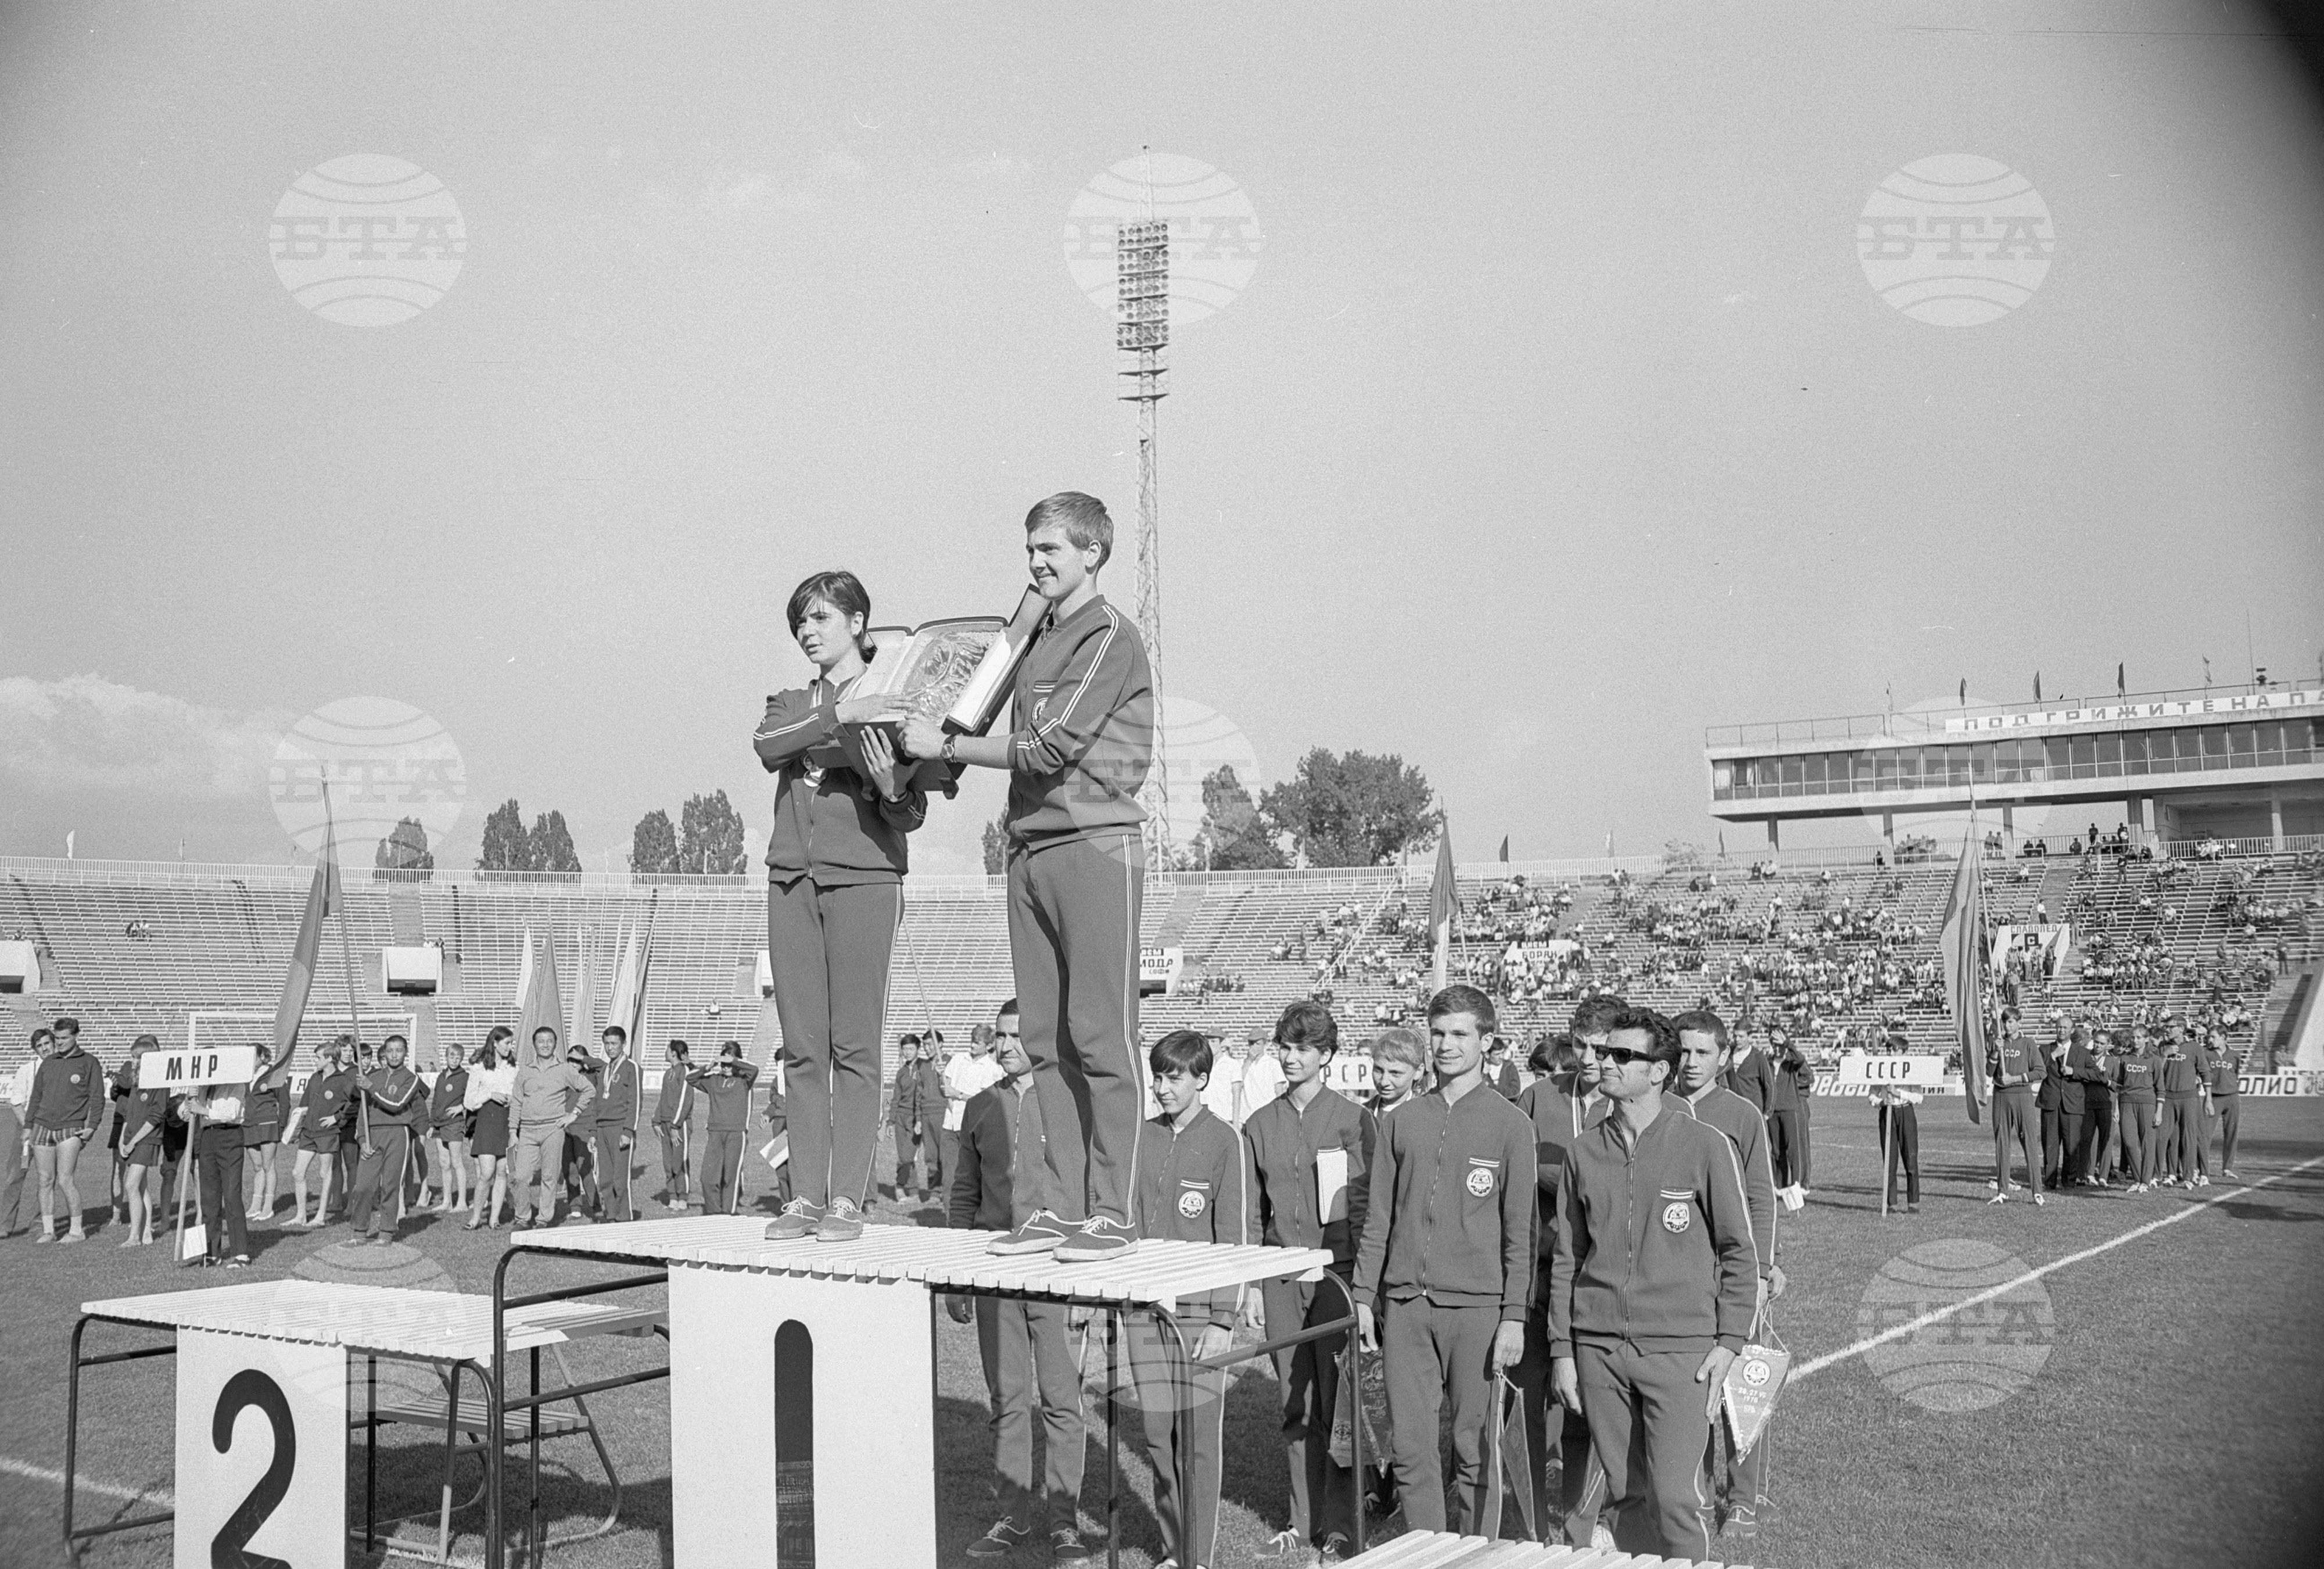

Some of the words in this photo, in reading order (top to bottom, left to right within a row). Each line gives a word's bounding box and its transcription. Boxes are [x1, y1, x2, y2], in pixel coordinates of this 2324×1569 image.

[1964, 714, 2031, 730] ПОД
[2232, 695, 2269, 710] НА
[166, 1054, 218, 1080] МНР
[1866, 1062, 1911, 1079] СССР
[2126, 1063, 2147, 1073] СССР
[2210, 1060, 2233, 1070] СССР
[211, 1369, 296, 1569] 2
